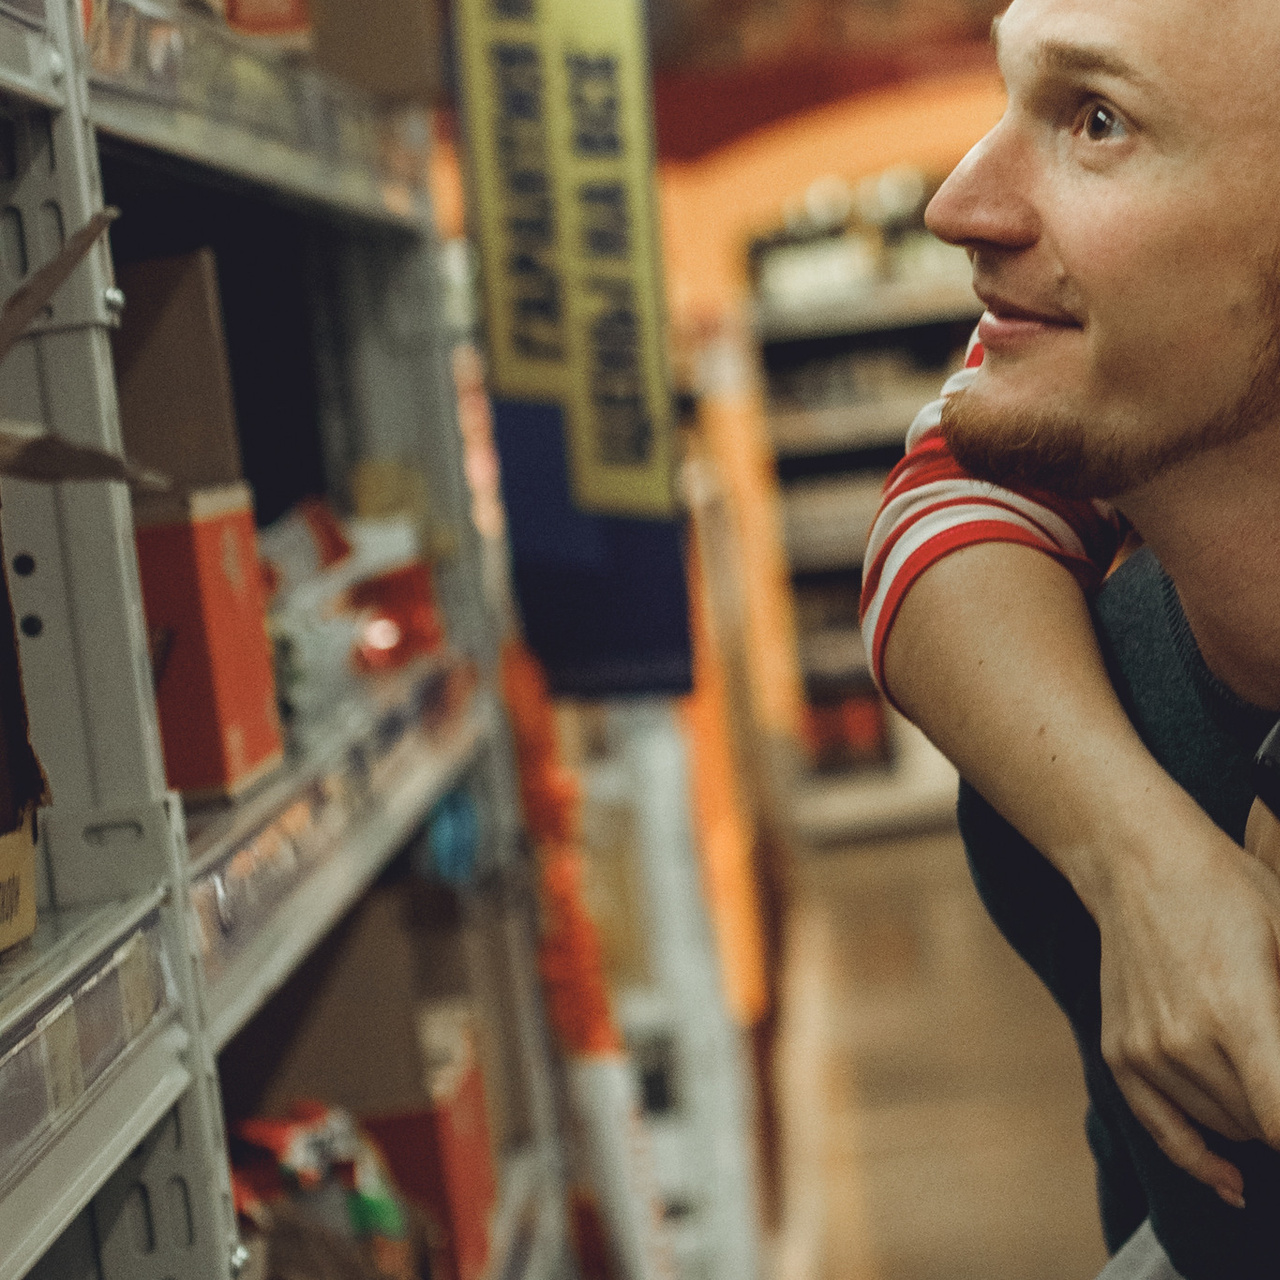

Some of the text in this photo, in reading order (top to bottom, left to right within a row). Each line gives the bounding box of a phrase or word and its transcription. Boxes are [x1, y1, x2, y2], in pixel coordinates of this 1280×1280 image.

[488, 40, 568, 363] ГАРАНТИЯ
[576, 178, 632, 261] НА
[583, 275, 654, 467] ЦЕНЫ
